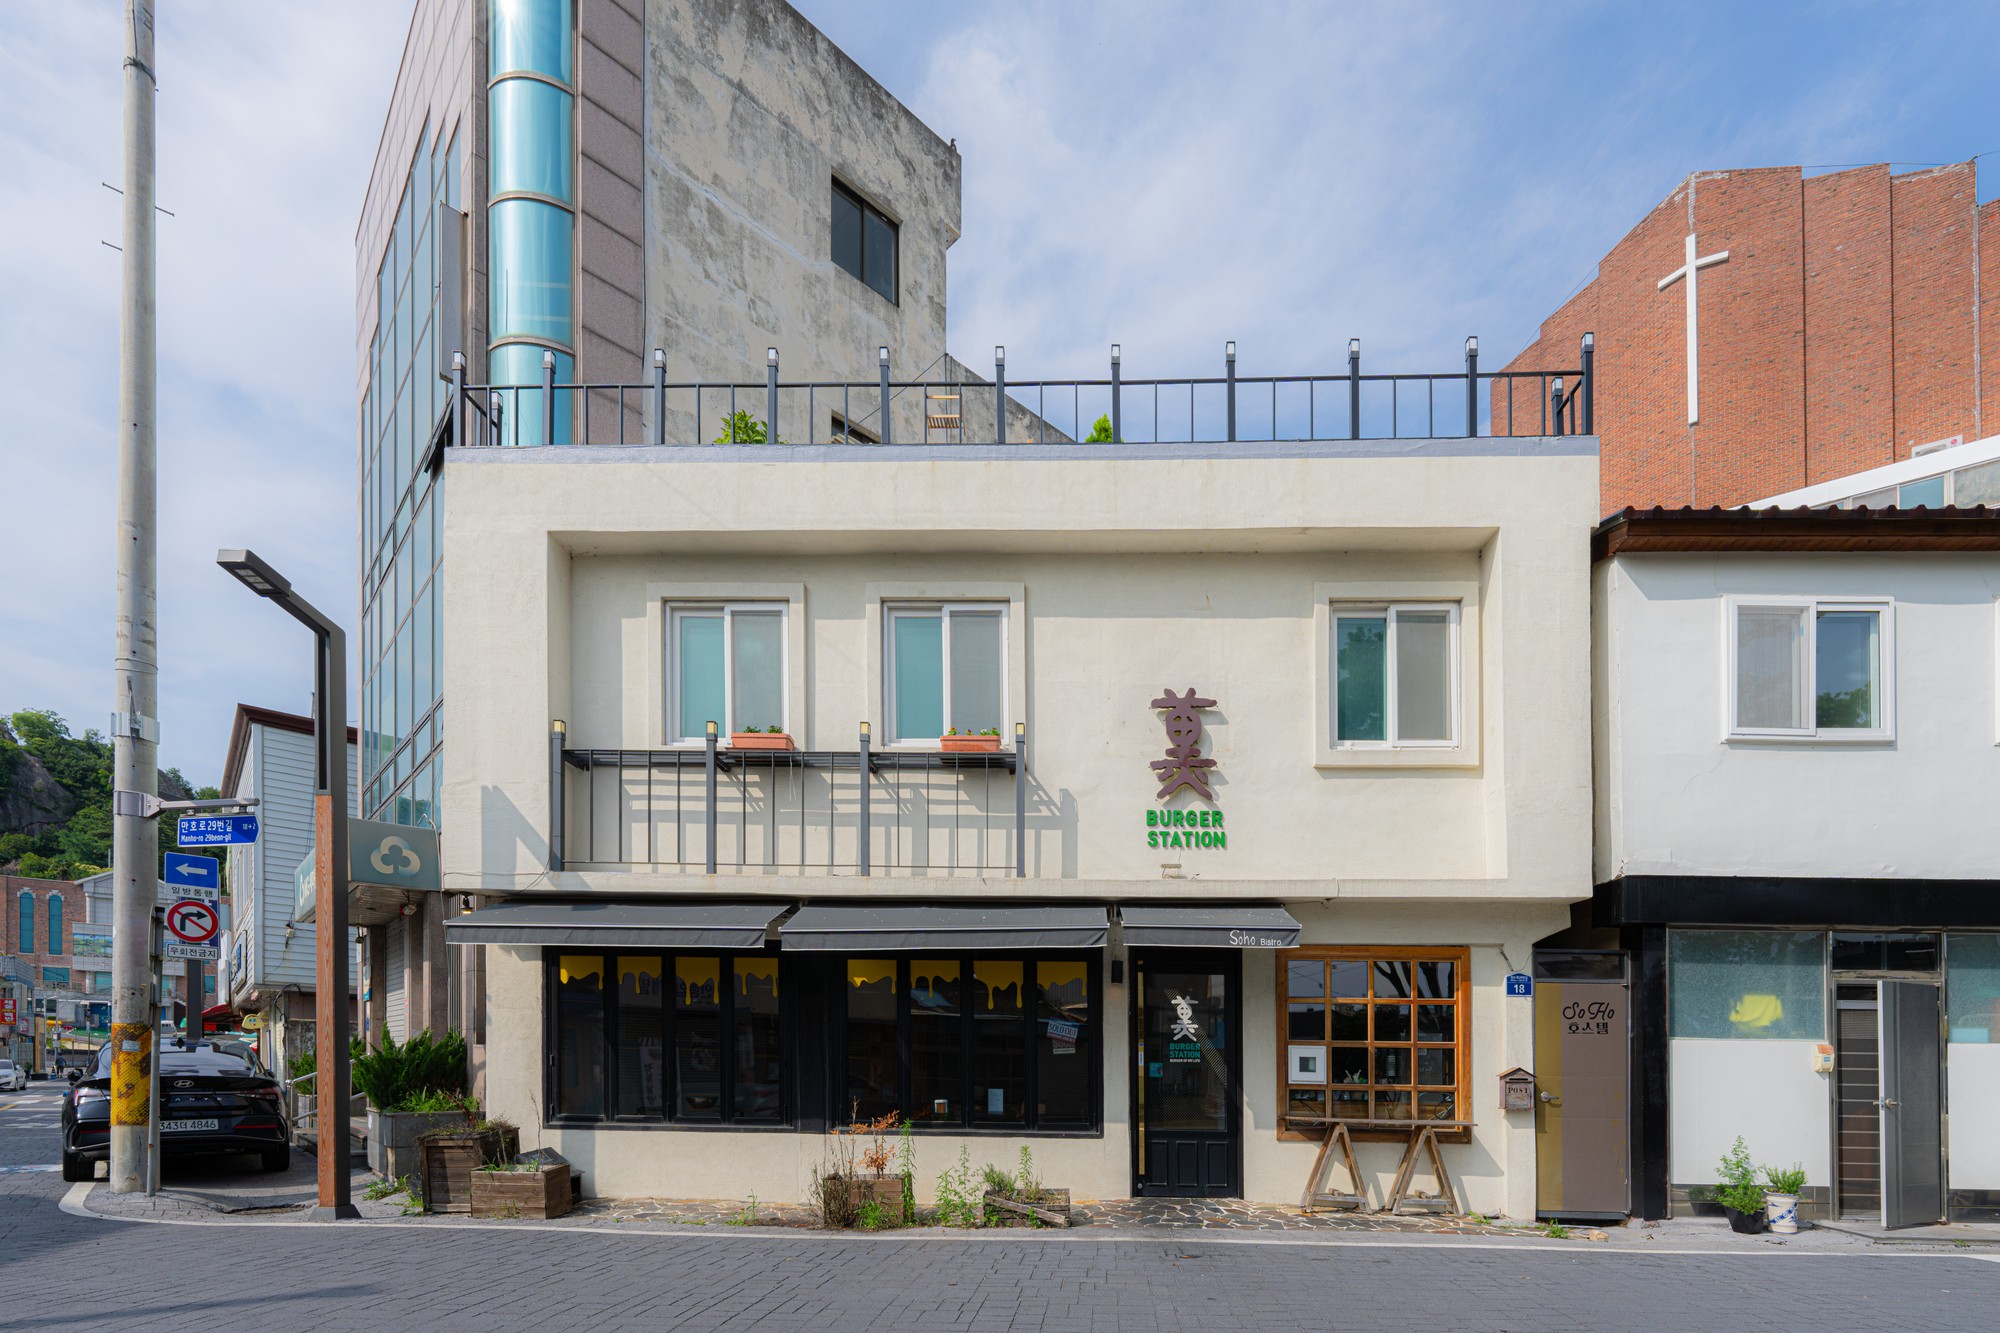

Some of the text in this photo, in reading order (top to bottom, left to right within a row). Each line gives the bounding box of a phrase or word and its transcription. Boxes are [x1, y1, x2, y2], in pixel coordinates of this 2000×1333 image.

[1146, 809, 1224, 828] BURGER
[181, 819, 233, 833] 만호로29번길
[181, 833, 232, 843] Manho-ro 29beon-gil
[1147, 830, 1226, 848] STATION
[171, 886, 213, 899] 일방통행
[1229, 929, 1282, 946] Soho Bistro
[169, 946, 216, 959] 우회전금지
[1513, 983, 1525, 994] 18
[1048, 1023, 1065, 1034] SOLD
[1064, 1027, 1077, 1037] OUT
[1567, 1022, 1609, 1035] 호스텔
[190, 1120, 217, 1130] 4846
